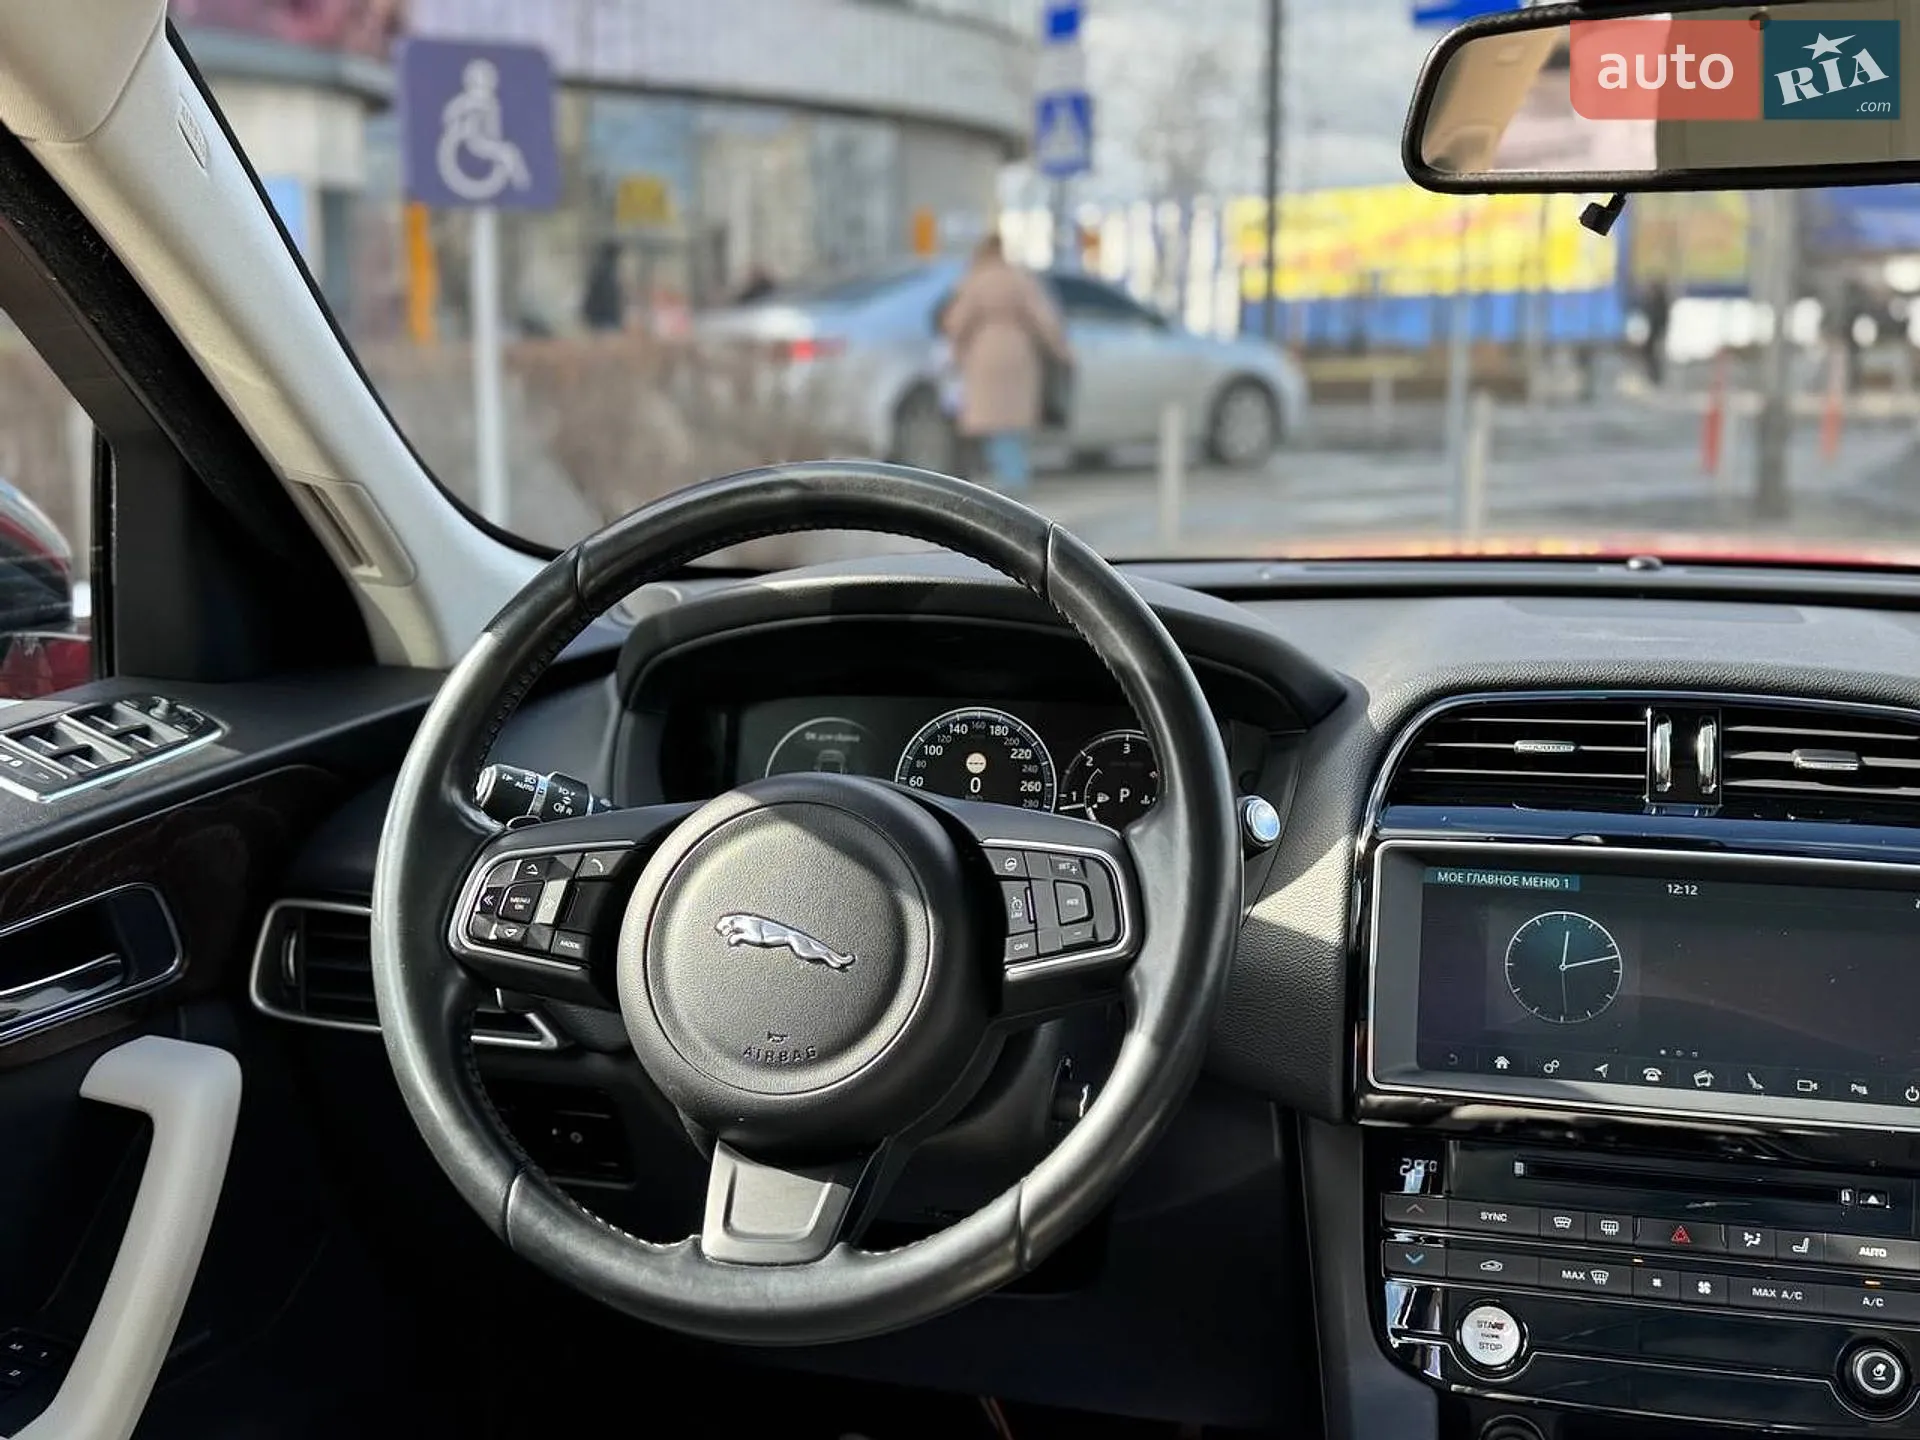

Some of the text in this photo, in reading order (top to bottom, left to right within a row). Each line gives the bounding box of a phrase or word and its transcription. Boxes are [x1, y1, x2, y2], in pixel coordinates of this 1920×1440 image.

[949, 723, 968, 734] 140
[989, 725, 1009, 736] 180
[924, 745, 943, 756] 100
[1010, 748, 1032, 760] 220
[1123, 743, 1131, 754] 3
[1085, 755, 1094, 767] 2
[908, 775, 924, 787] 60
[970, 776, 981, 793] 0
[1020, 780, 1042, 792] 260
[1119, 787, 1131, 803] P
[1466, 872, 1520, 886] ГЛАВНОЕ
[1522, 875, 1560, 888] МЕНЮ
[1667, 883, 1699, 896] 12:12
[742, 1045, 817, 1063] AIRBAG
[1480, 1211, 1508, 1222] SYNC
[1859, 1246, 1887, 1258] AUTO
[1561, 1269, 1586, 1281] MAX
[1752, 1287, 1803, 1301] MAX A/C
[1862, 1296, 1884, 1307] A/C
[1478, 1341, 1503, 1352] STOP
